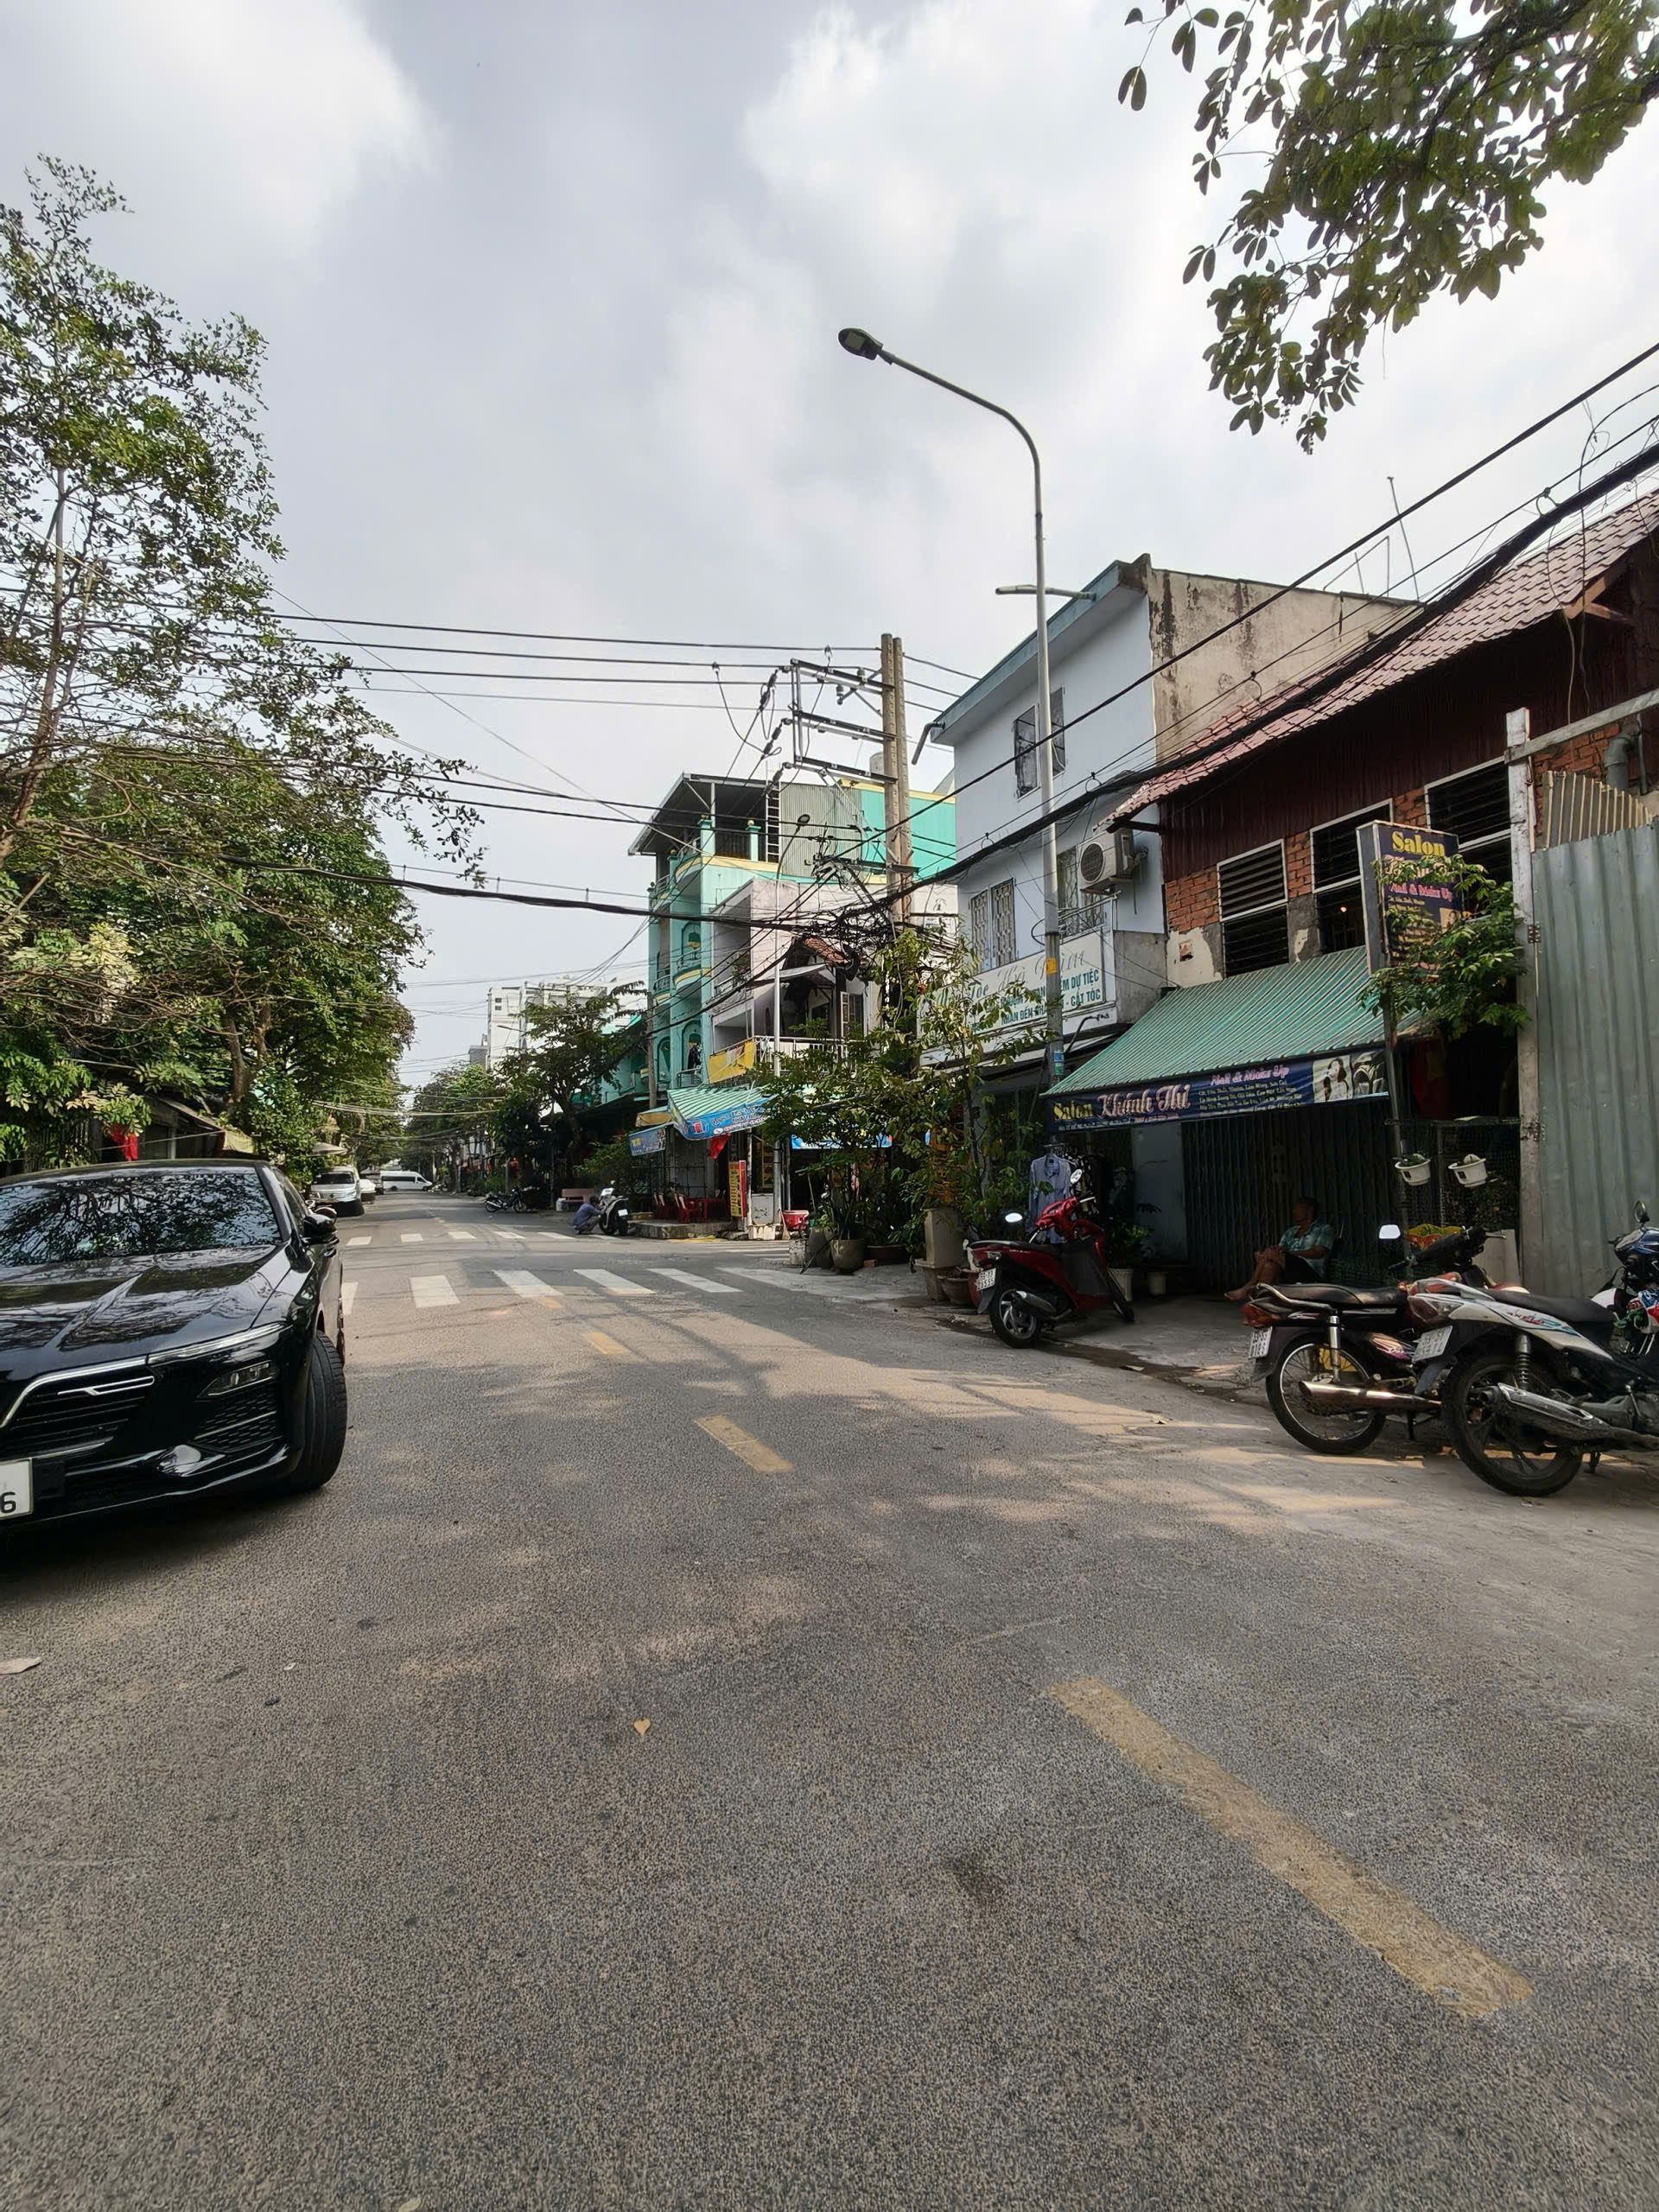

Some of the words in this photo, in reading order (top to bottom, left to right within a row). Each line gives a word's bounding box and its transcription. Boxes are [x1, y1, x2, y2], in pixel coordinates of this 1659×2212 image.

[1392, 830, 1445, 857] Salon
[1083, 969, 1099, 986] TIỆC
[1086, 988, 1100, 1002] TÓC
[1053, 1101, 1093, 1121] Salon
[1097, 1089, 1154, 1117] Khánh
